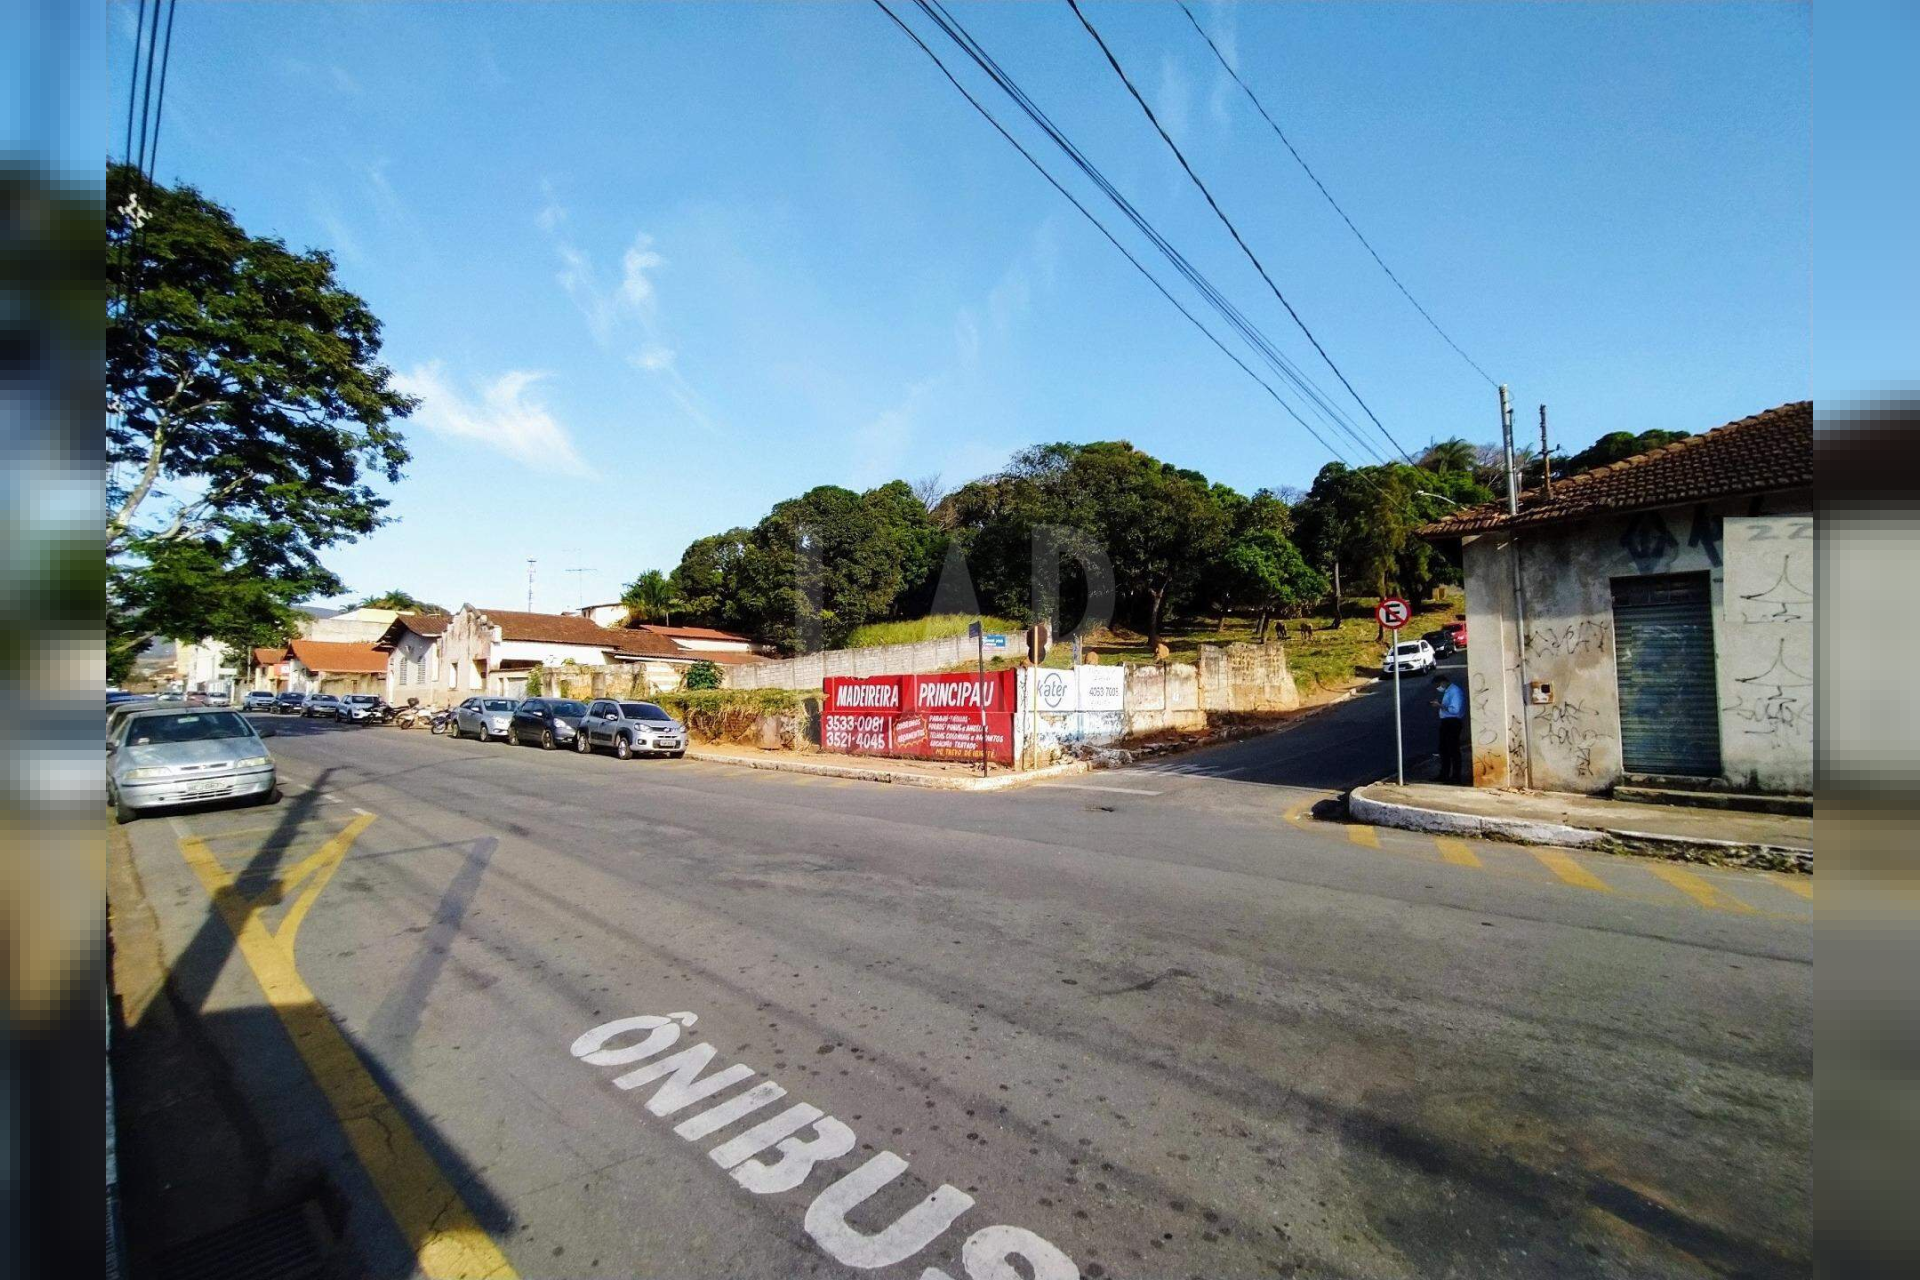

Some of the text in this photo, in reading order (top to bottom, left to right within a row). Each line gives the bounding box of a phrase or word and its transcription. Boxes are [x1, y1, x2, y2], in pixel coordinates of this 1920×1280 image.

[1385, 603, 1401, 623] E
[837, 685, 899, 707] MADEIREIRA
[826, 715, 884, 732] 3533-0081
[826, 732, 885, 749] 3521-4045
